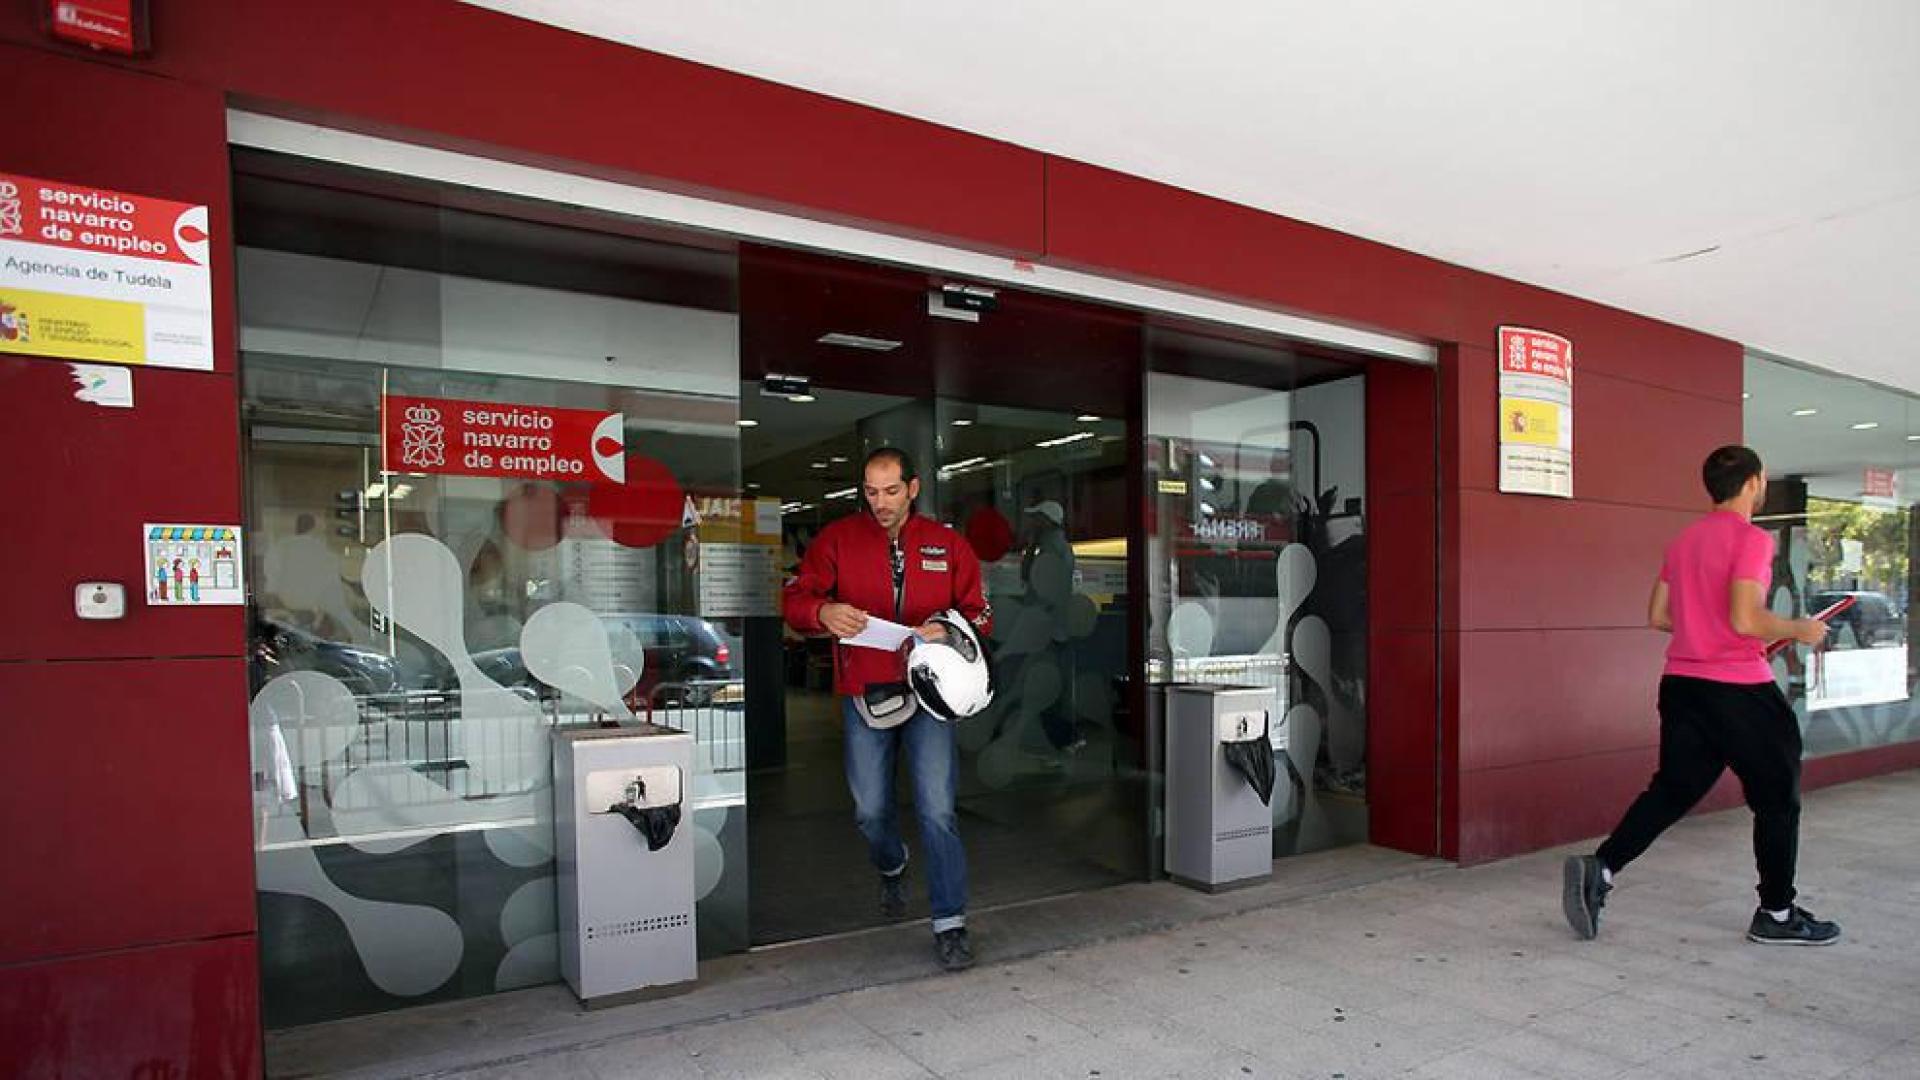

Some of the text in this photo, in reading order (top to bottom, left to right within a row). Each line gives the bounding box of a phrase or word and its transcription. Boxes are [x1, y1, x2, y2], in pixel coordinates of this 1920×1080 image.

[38, 187, 135, 214] servicio
[40, 207, 134, 232] navarro
[41, 224, 167, 254] de empleo
[5, 256, 172, 290] Agencia de Tudela
[463, 409, 553, 430] servicio
[463, 431, 551, 451] navarro
[464, 451, 584, 475] de empleo
